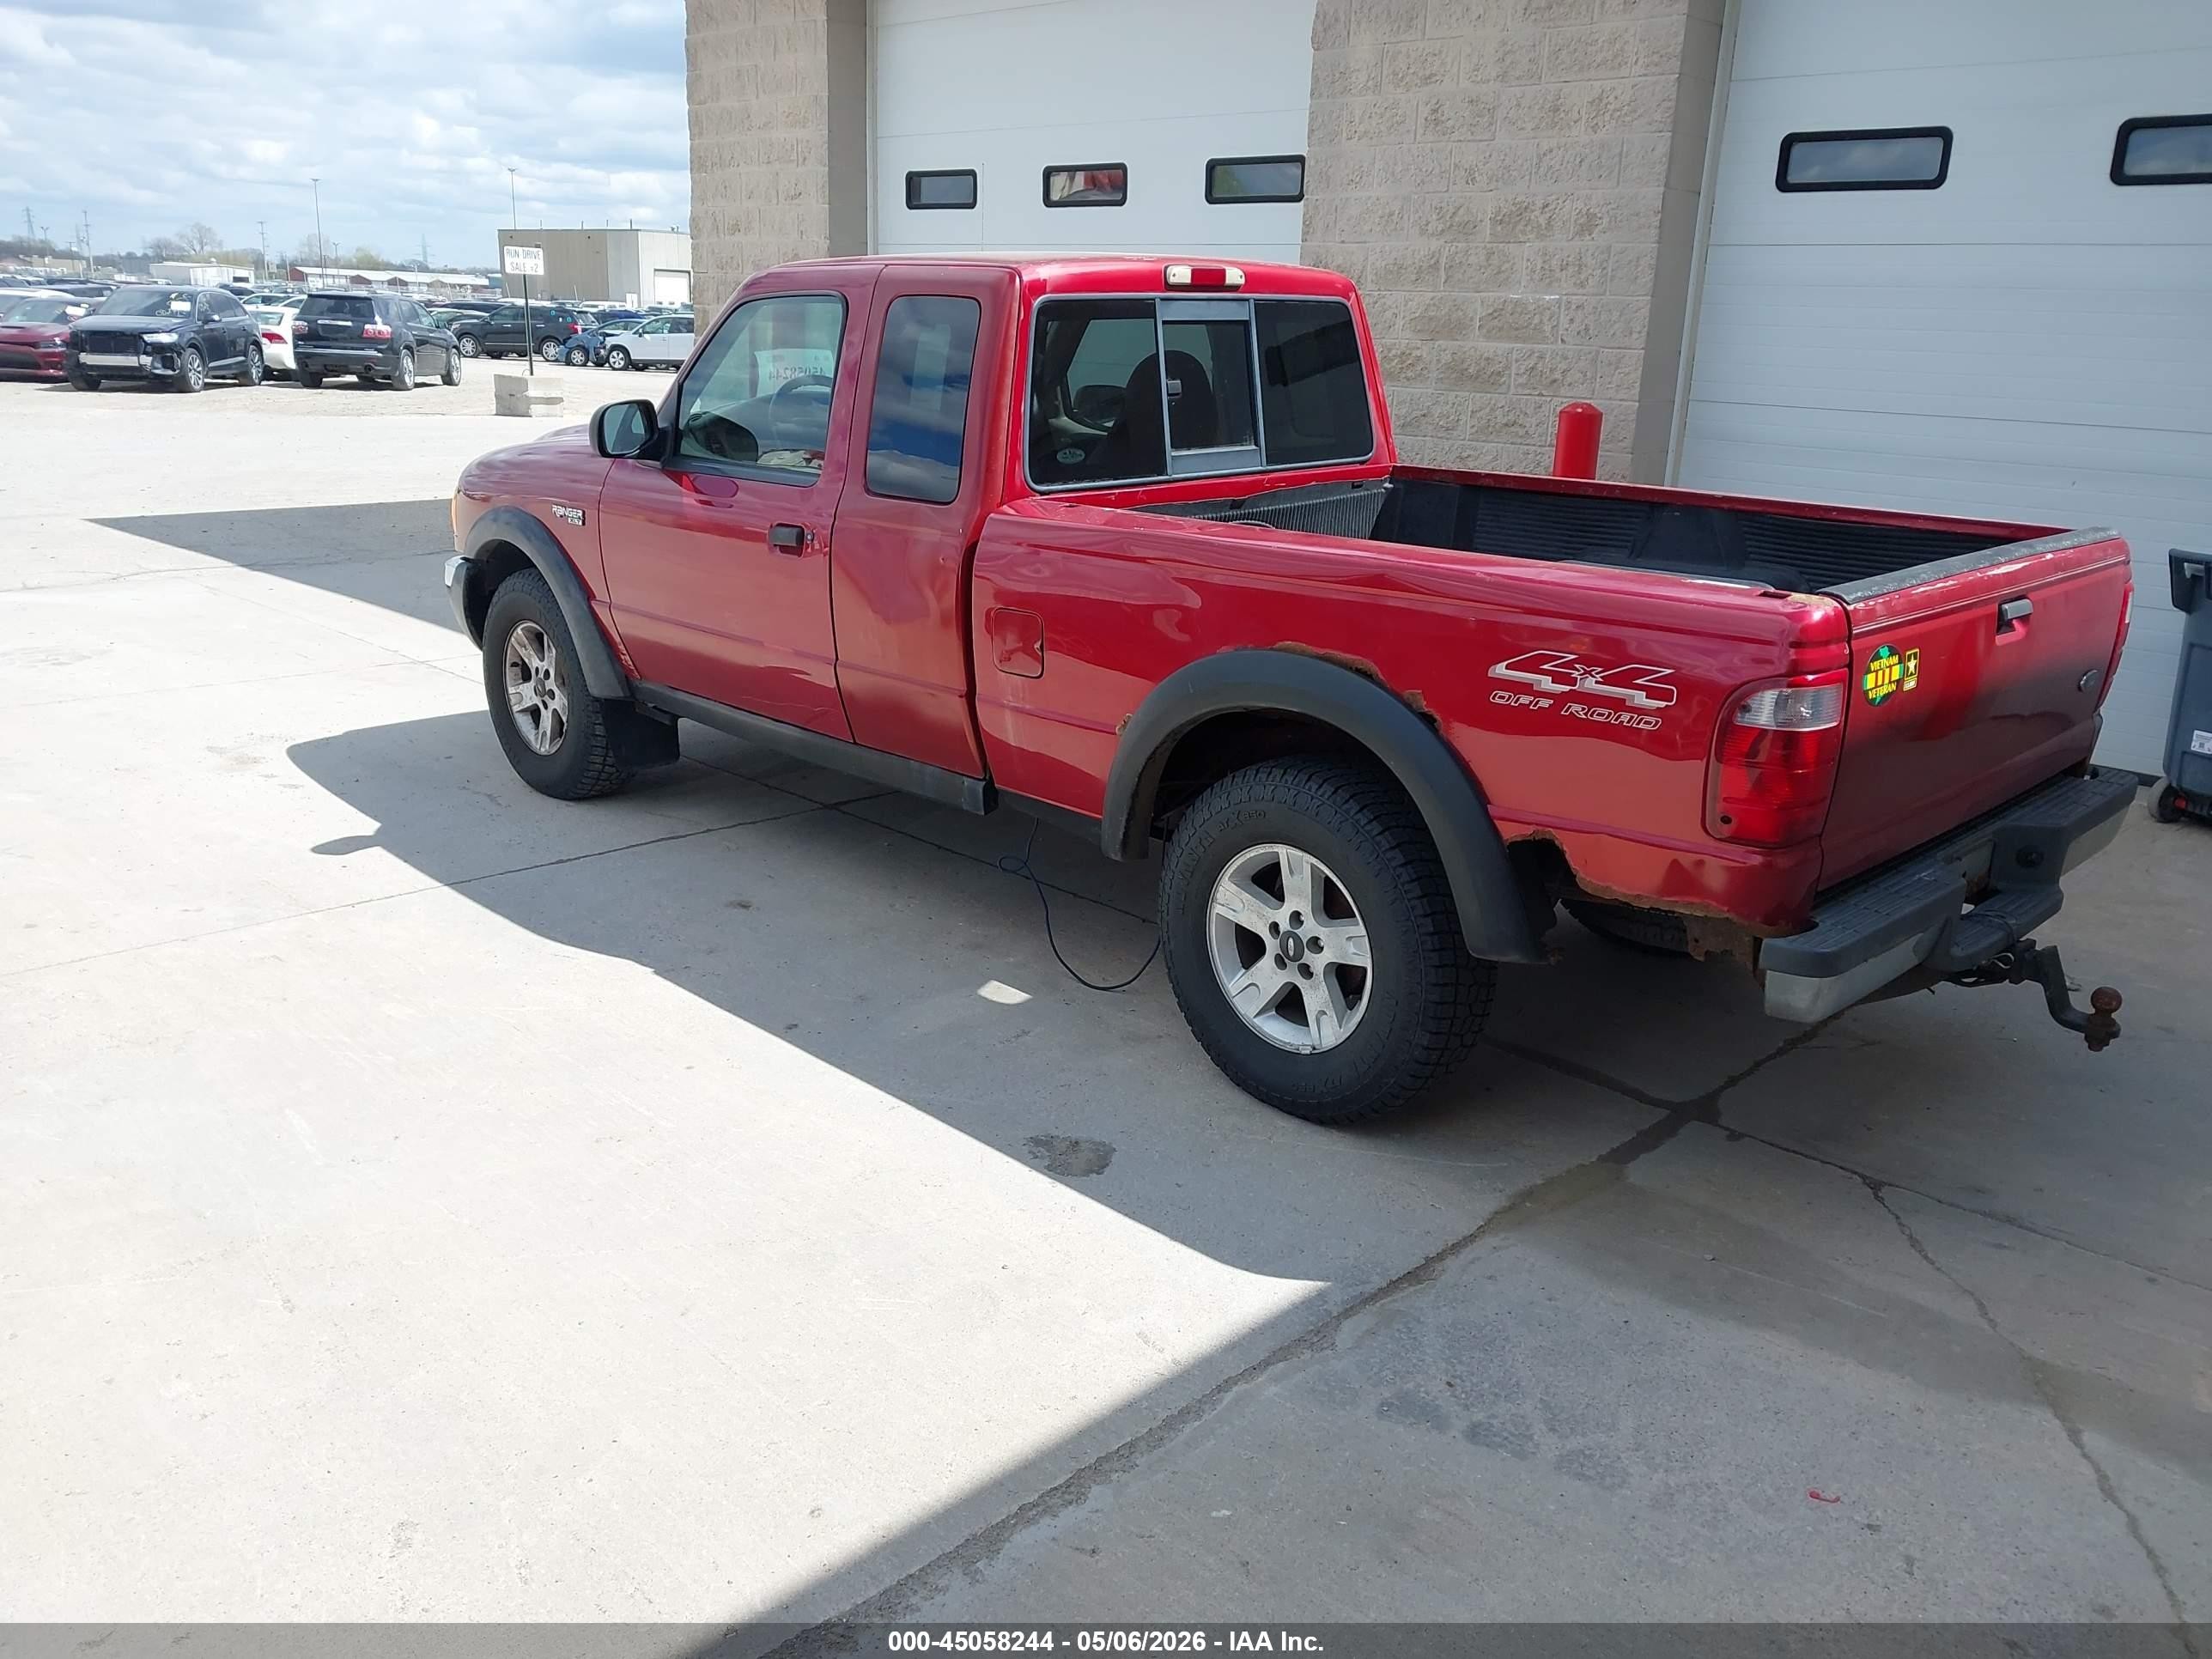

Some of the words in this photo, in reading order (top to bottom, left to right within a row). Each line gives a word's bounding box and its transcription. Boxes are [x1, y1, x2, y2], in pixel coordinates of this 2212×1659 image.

[510, 261, 526, 272] SALE
[551, 504, 582, 520] RANGER
[1870, 654, 1899, 672] VIETNAM
[1869, 682, 1897, 699] VETERAN
[1490, 690, 1553, 709] OFF
[1561, 702, 1662, 730] ROAD
